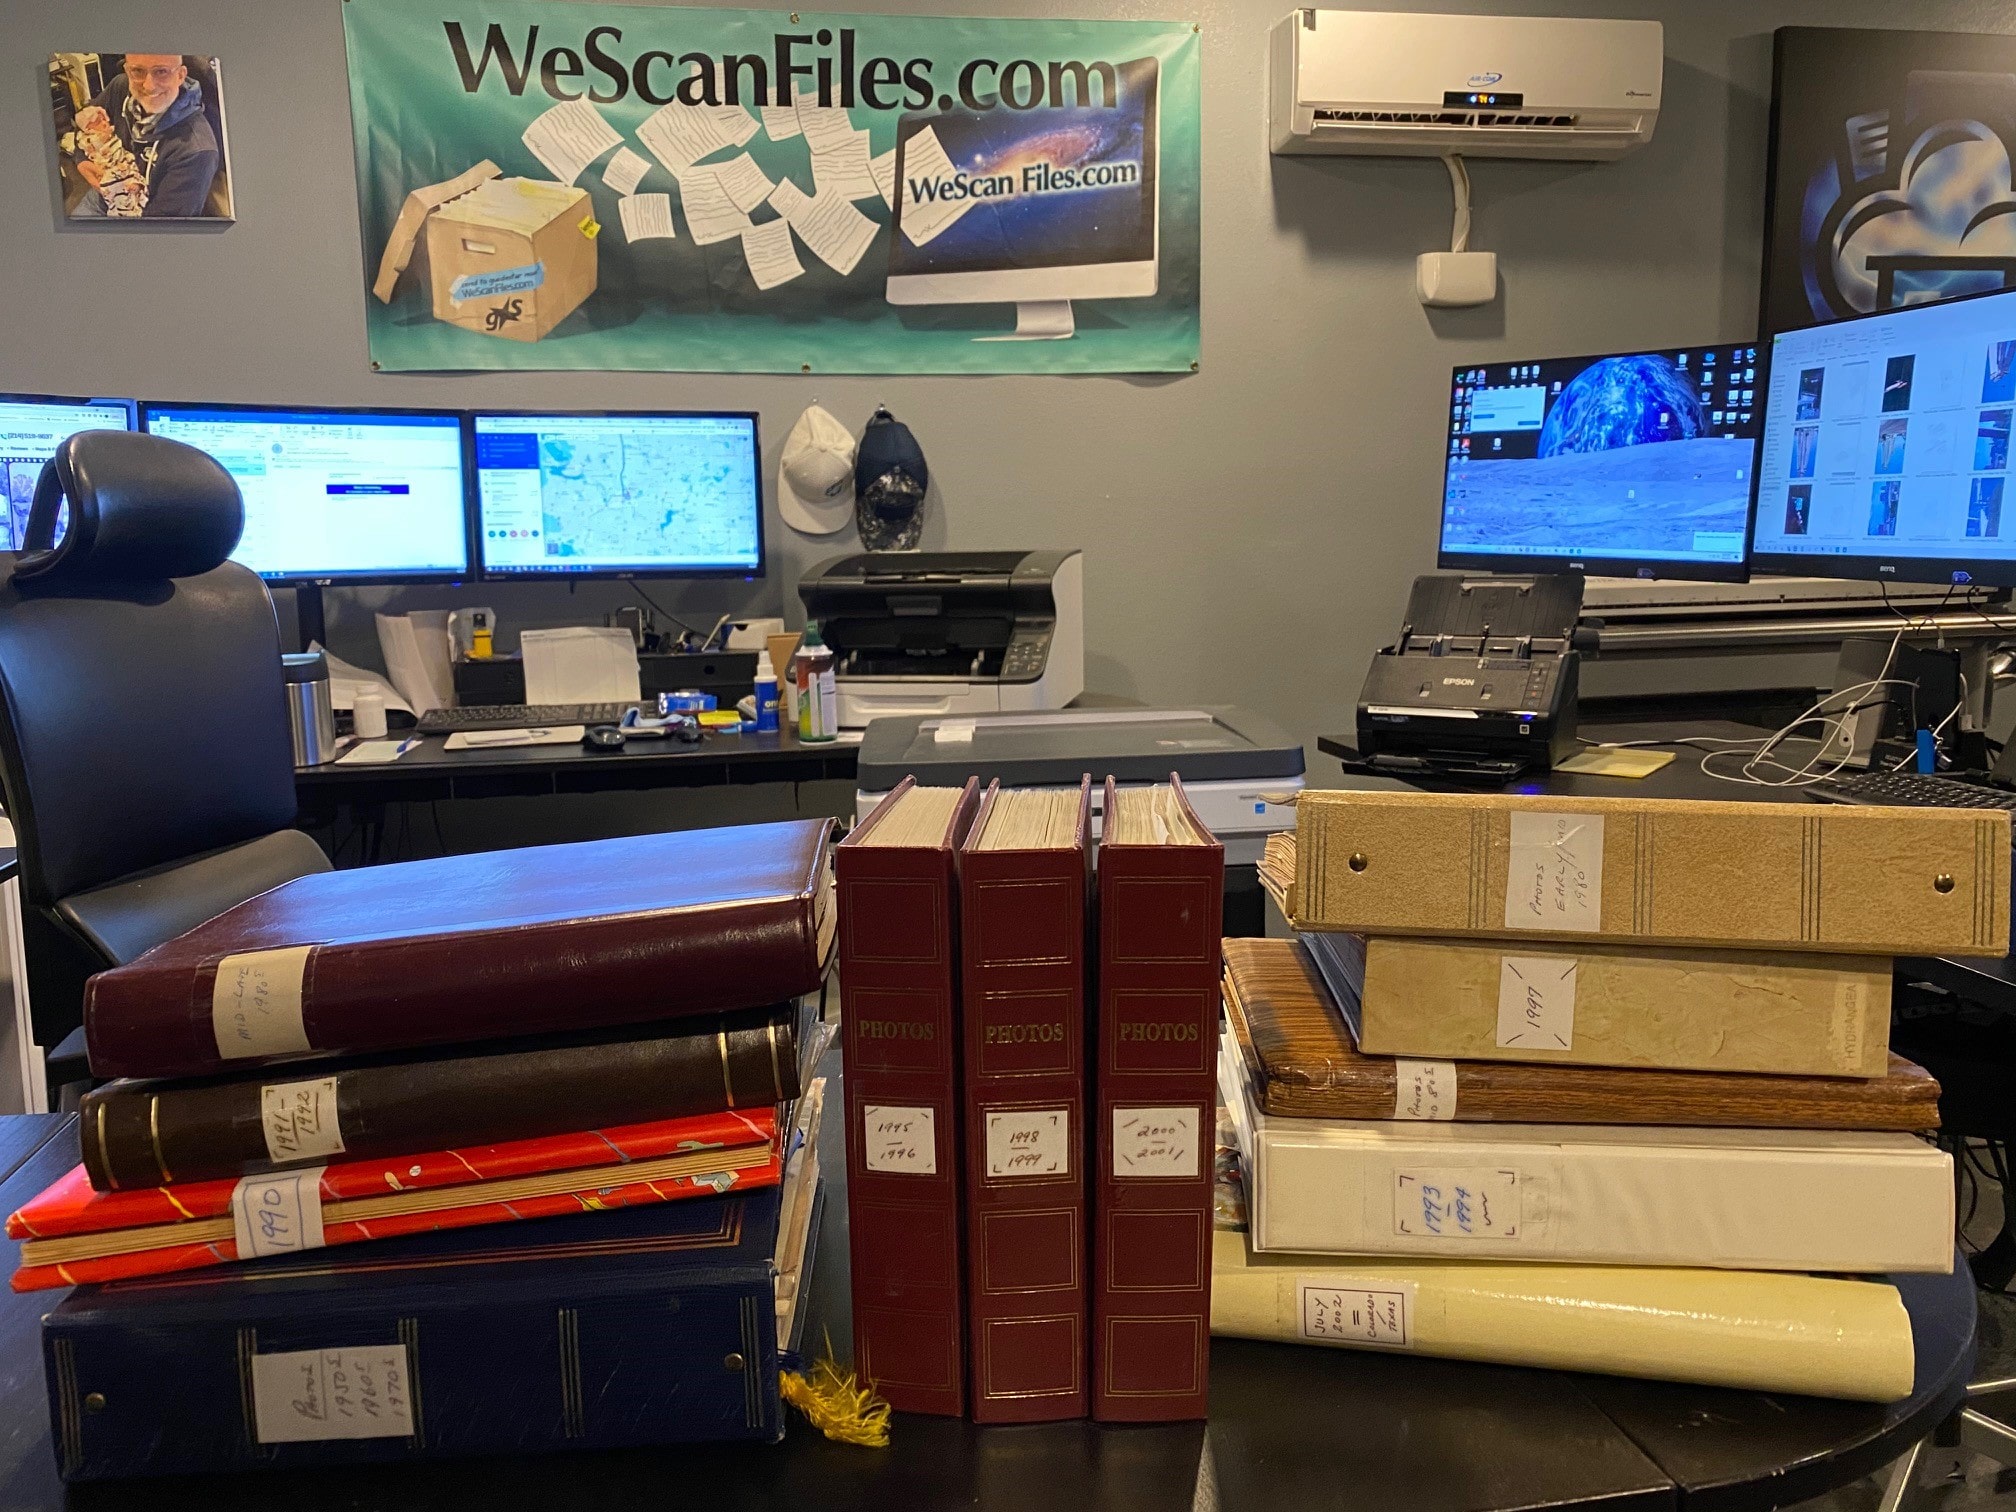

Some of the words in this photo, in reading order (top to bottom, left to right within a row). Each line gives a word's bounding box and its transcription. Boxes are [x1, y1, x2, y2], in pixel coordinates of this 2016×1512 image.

[442, 20, 1118, 112] WeScanFiles.com
[908, 172, 1014, 204] WeScan
[1022, 162, 1138, 193] Files.com
[461, 281, 534, 298] WeScanFiles.com
[1442, 677, 1475, 687] EPSON
[1526, 985, 1543, 1029] 1997
[858, 1019, 935, 1041] PHOTOS
[984, 1022, 1065, 1044] PHOTOS
[1119, 1022, 1199, 1042] PHOTOS
[296, 1090, 316, 1135] 1992
[273, 1111, 297, 1151] 1991
[877, 1121, 914, 1133] 1995
[1009, 1130, 1040, 1144] 1998
[1137, 1125, 1177, 1137] 2000
[880, 1147, 916, 1160] 1996
[1008, 1153, 1043, 1167] 1999
[1136, 1146, 1175, 1159] 2001
[258, 1188, 294, 1247] 1990
[1422, 1185, 1442, 1233] 1993
[1455, 1186, 1472, 1233] 1994
[1314, 1297, 1329, 1334] JULY
[1332, 1294, 1343, 1333] 2002
[1387, 1300, 1398, 1332] TEXAS
